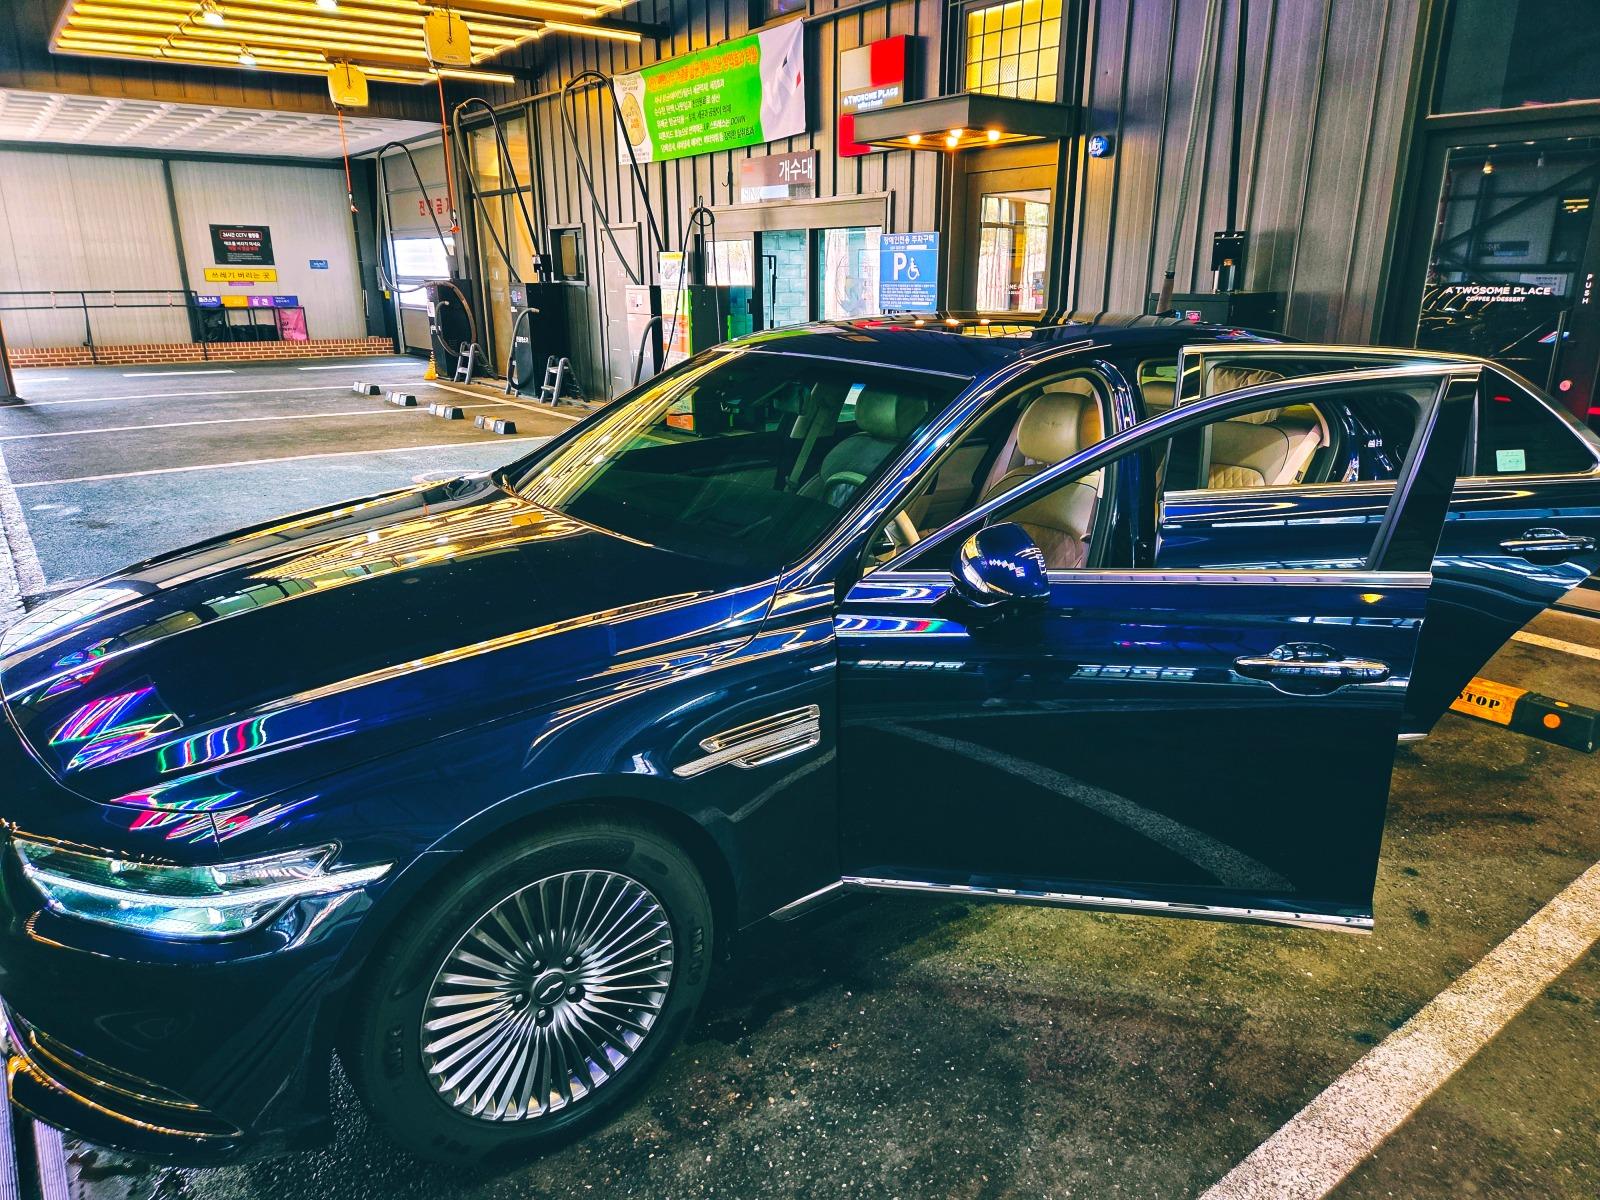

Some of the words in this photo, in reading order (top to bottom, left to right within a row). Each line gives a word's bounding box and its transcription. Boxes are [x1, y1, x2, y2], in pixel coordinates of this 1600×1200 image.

[779, 156, 813, 181] 개수대
[911, 234, 935, 243] 주차구역
[893, 252, 908, 280] P
[212, 271, 235, 279] 쓰레기
[1455, 286, 1510, 295] TWOSOME
[1513, 287, 1551, 295] PLACE
[1582, 273, 1594, 305] PUSH
[1458, 692, 1500, 708] STOP
